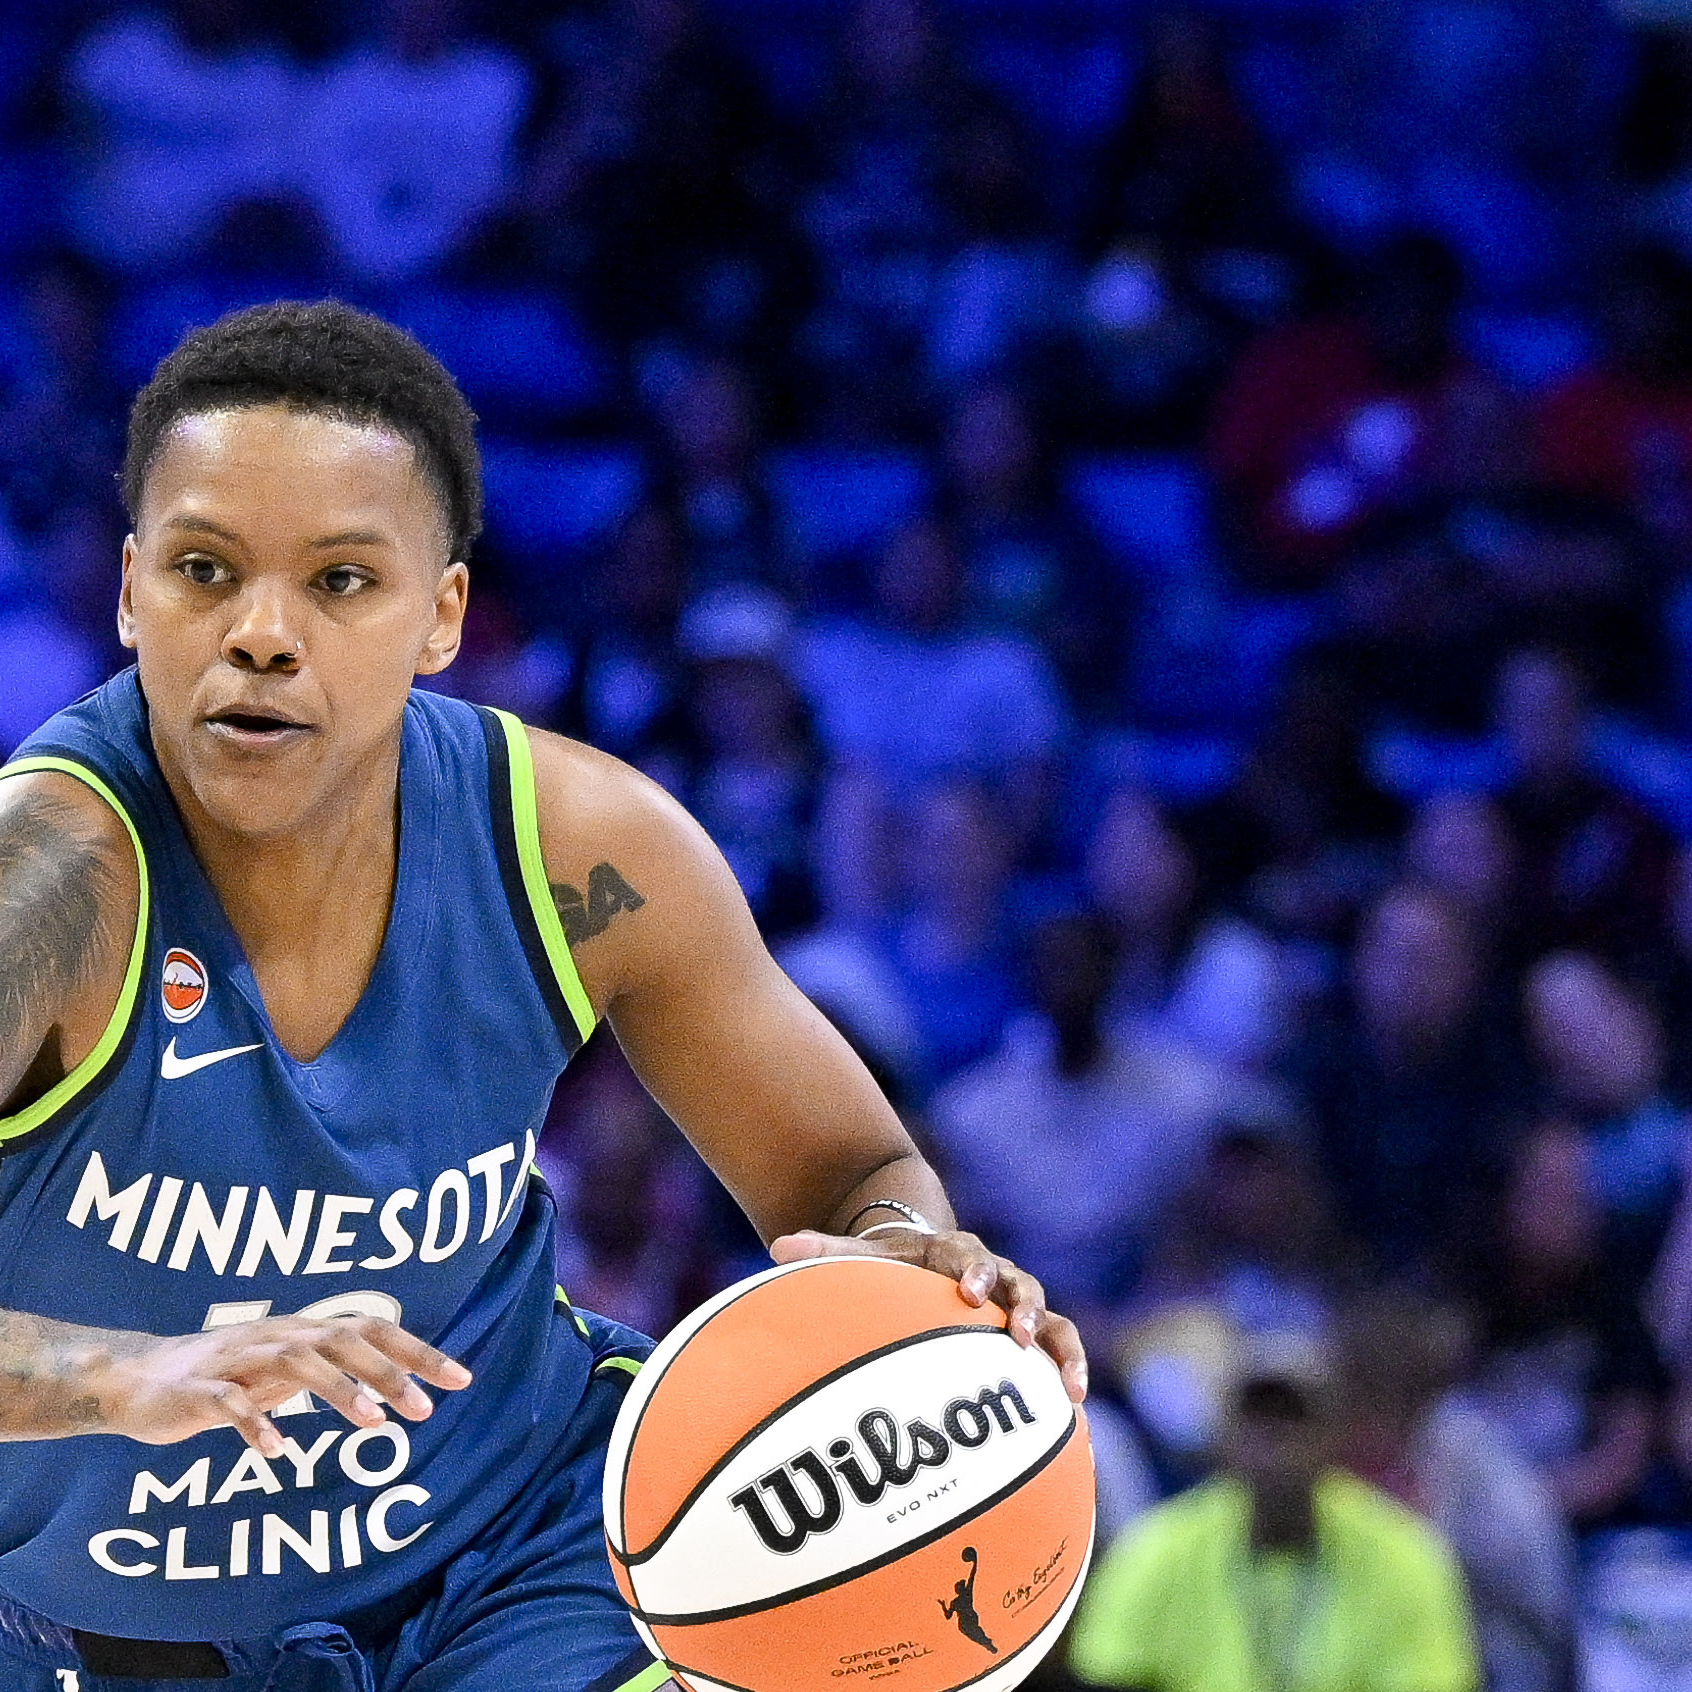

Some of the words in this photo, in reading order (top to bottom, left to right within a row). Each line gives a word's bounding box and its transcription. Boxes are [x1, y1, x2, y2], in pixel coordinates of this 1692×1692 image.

[128, 1420, 410, 1515] MAYO
[728, 1378, 1036, 1555] Wilson
[886, 1501, 921, 1524] EVO
[927, 1479, 959, 1501] NXT
[87, 1484, 433, 1581] CLINIC
[831, 1661, 885, 1677] GAME
[888, 1647, 934, 1666] BALL
[839, 1640, 919, 1664] OFFICIAL
